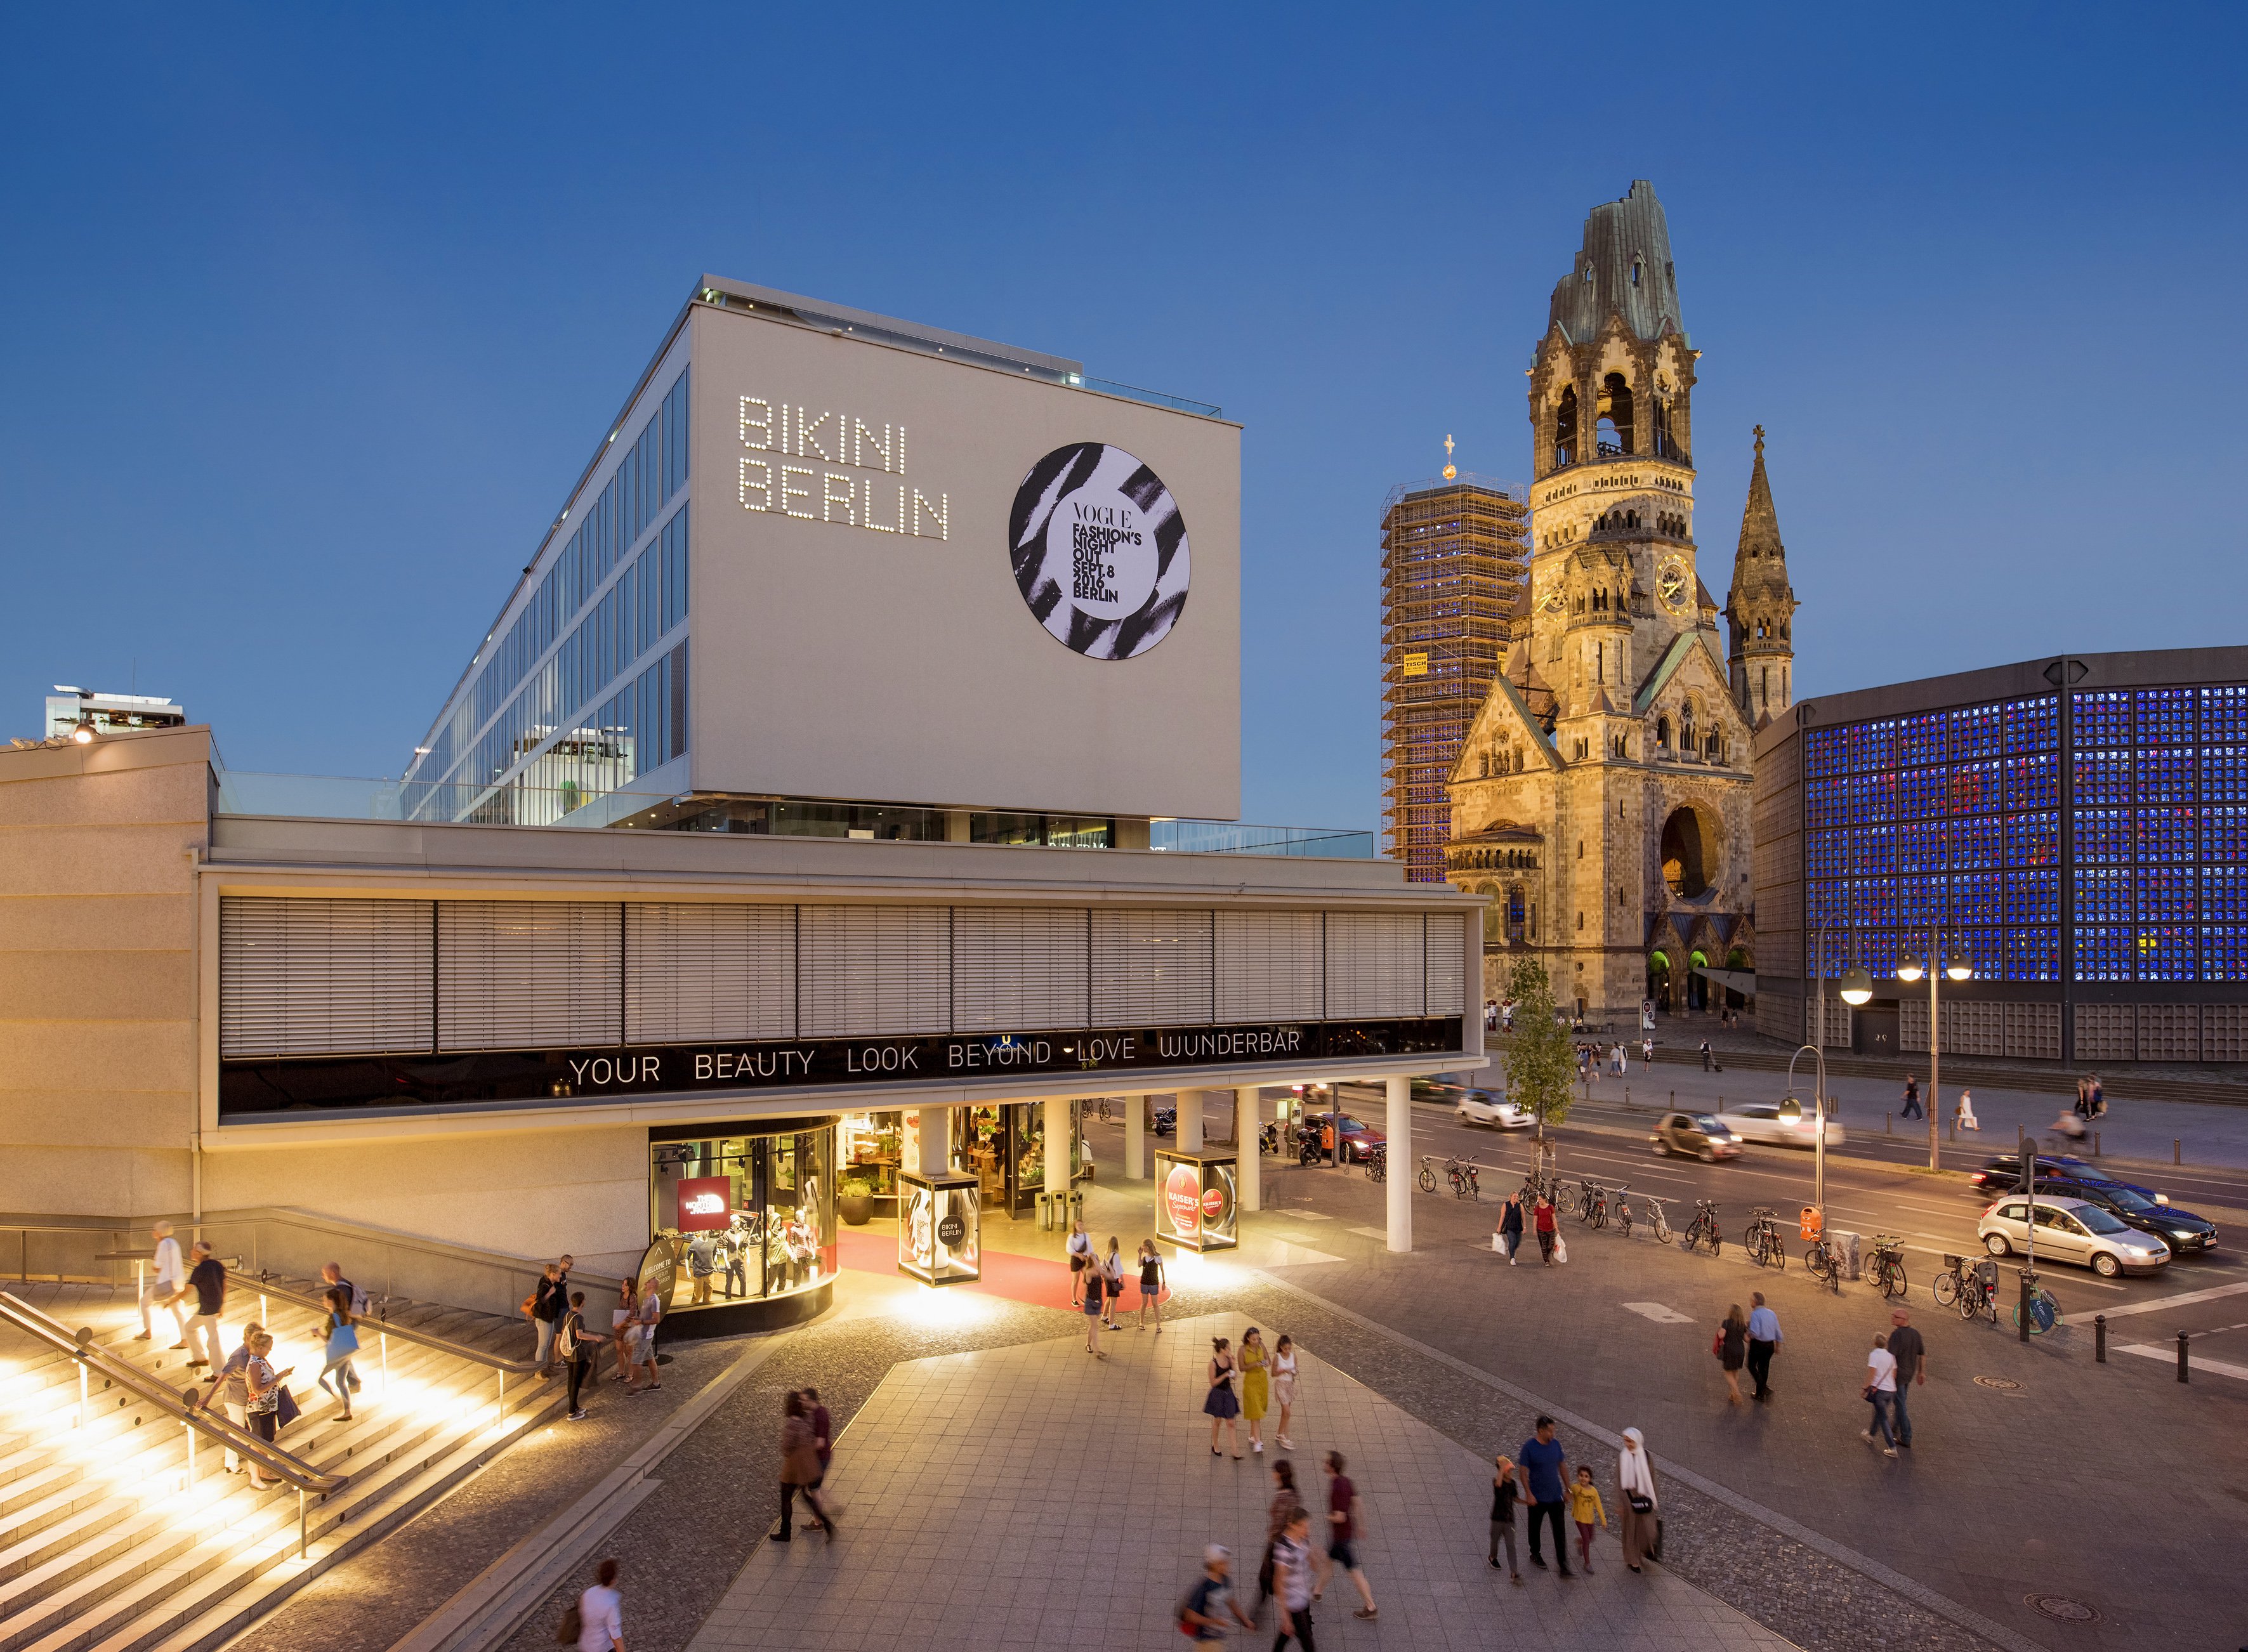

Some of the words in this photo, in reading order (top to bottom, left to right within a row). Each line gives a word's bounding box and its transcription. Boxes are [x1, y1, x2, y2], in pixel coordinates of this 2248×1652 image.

[739, 395, 905, 475] BIKINI
[739, 456, 948, 541] BERLIN
[1073, 502, 1132, 529] VOGUE
[1072, 522, 1142, 546] FASHION'S
[1073, 534, 1117, 554] NIGHT
[1072, 547, 1101, 566] OUT
[1072, 560, 1105, 577] SEPT.
[1107, 565, 1115, 579] 8
[1072, 572, 1105, 589] 2016
[1073, 581, 1119, 603] BERLIN
[569, 1056, 661, 1085] YOUR
[695, 1050, 815, 1080] BEAUTY
[848, 1046, 919, 1073] LOOK
[949, 1041, 1051, 1068] BEYOND
[1078, 1037, 1135, 1062] LOVE
[1160, 1030, 1300, 1058] WUNDERBAR
[1168, 1191, 1199, 1207] KAISER'S
[942, 1229, 962, 1237] BERLIN
[644, 1261, 665, 1276] WELCOME
[666, 1258, 671, 1266] TO
